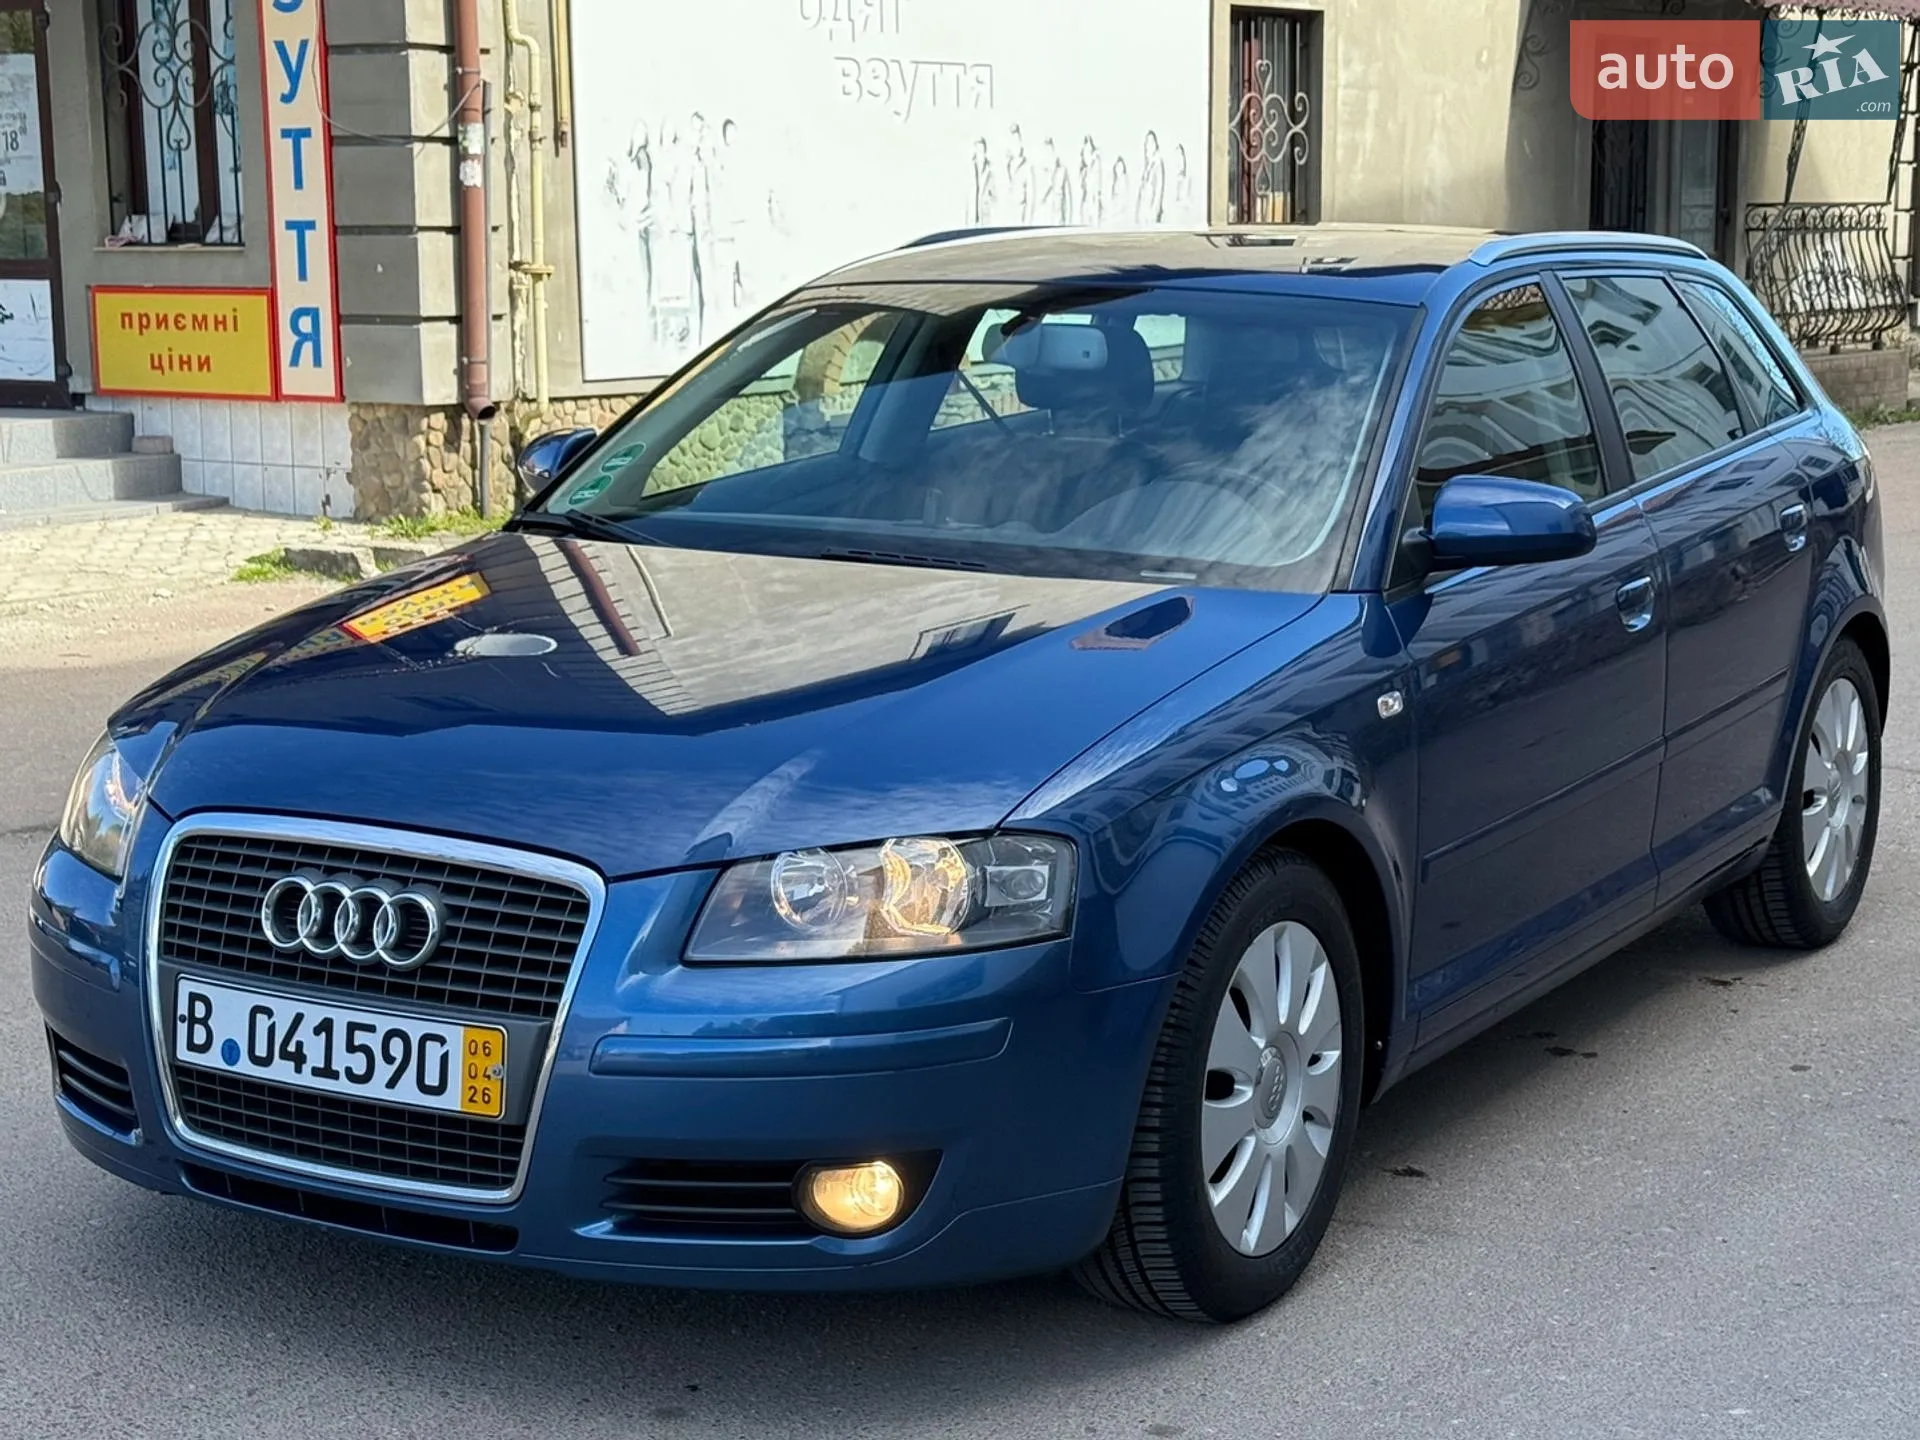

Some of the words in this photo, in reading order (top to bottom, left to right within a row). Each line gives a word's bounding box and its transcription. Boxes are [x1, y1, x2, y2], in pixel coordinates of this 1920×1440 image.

[272, 0, 323, 368] УТТЯ
[120, 307, 239, 336] приємні
[149, 347, 212, 376] ціни
[186, 991, 214, 1054] B
[248, 1004, 450, 1097] 041590
[468, 1039, 492, 1058] 06
[467, 1062, 492, 1081] 04
[467, 1085, 492, 1105] 26
